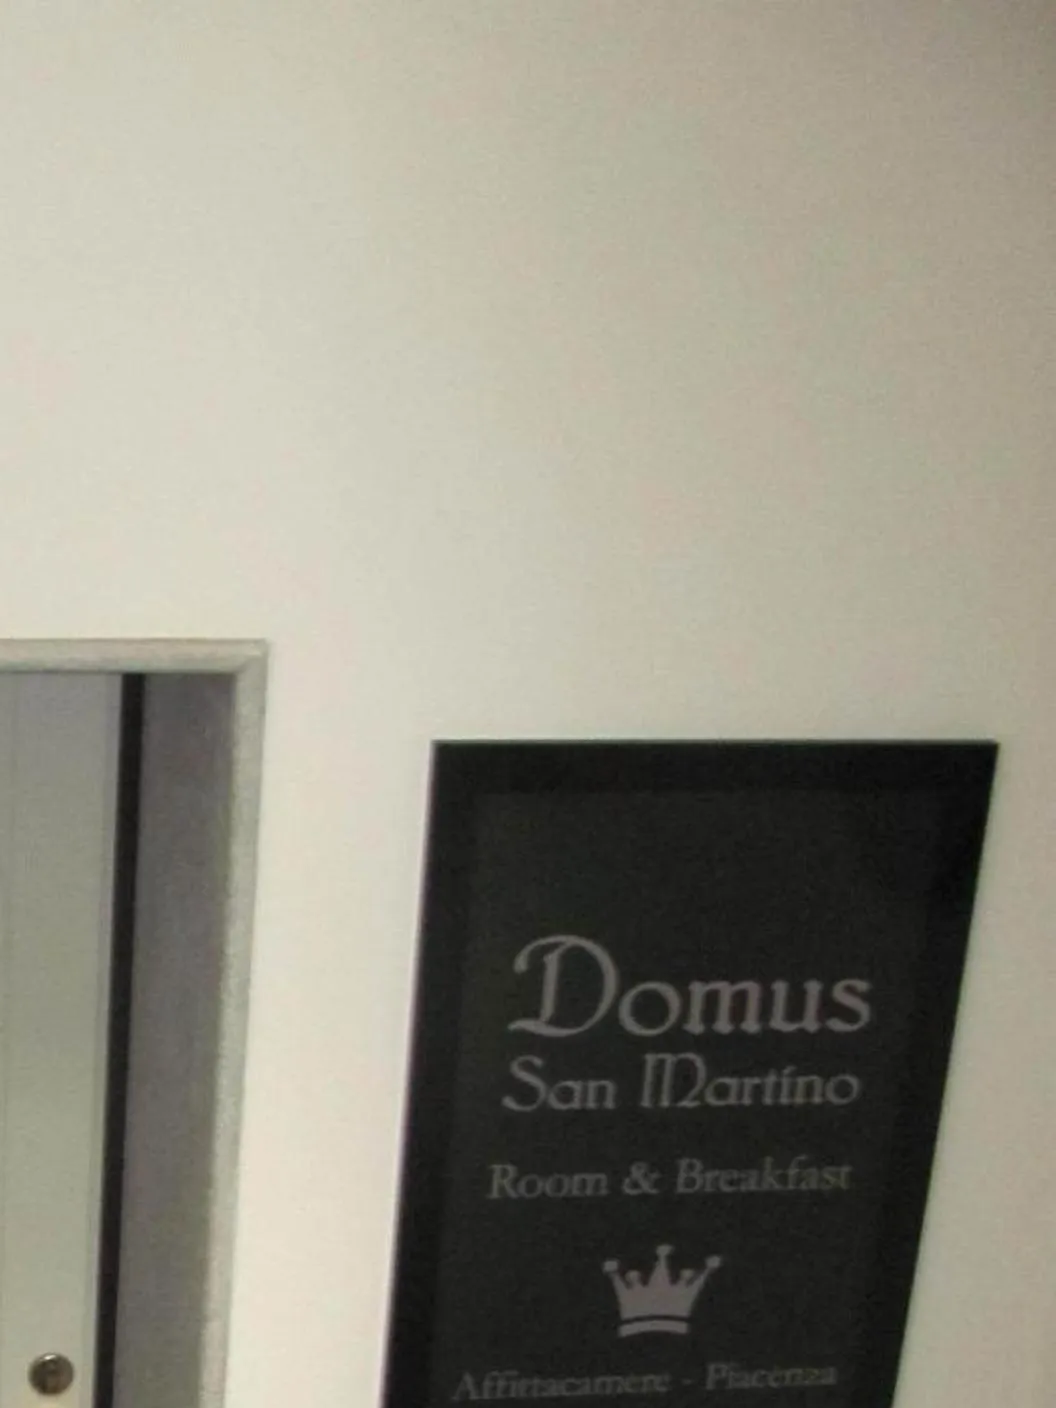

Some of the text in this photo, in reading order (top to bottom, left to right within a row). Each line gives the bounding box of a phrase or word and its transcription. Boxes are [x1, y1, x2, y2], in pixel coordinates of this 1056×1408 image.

[507, 934, 873, 1037] Domus
[501, 1052, 861, 1112] San Martino
[488, 1155, 853, 1199] Room & Breakfast
